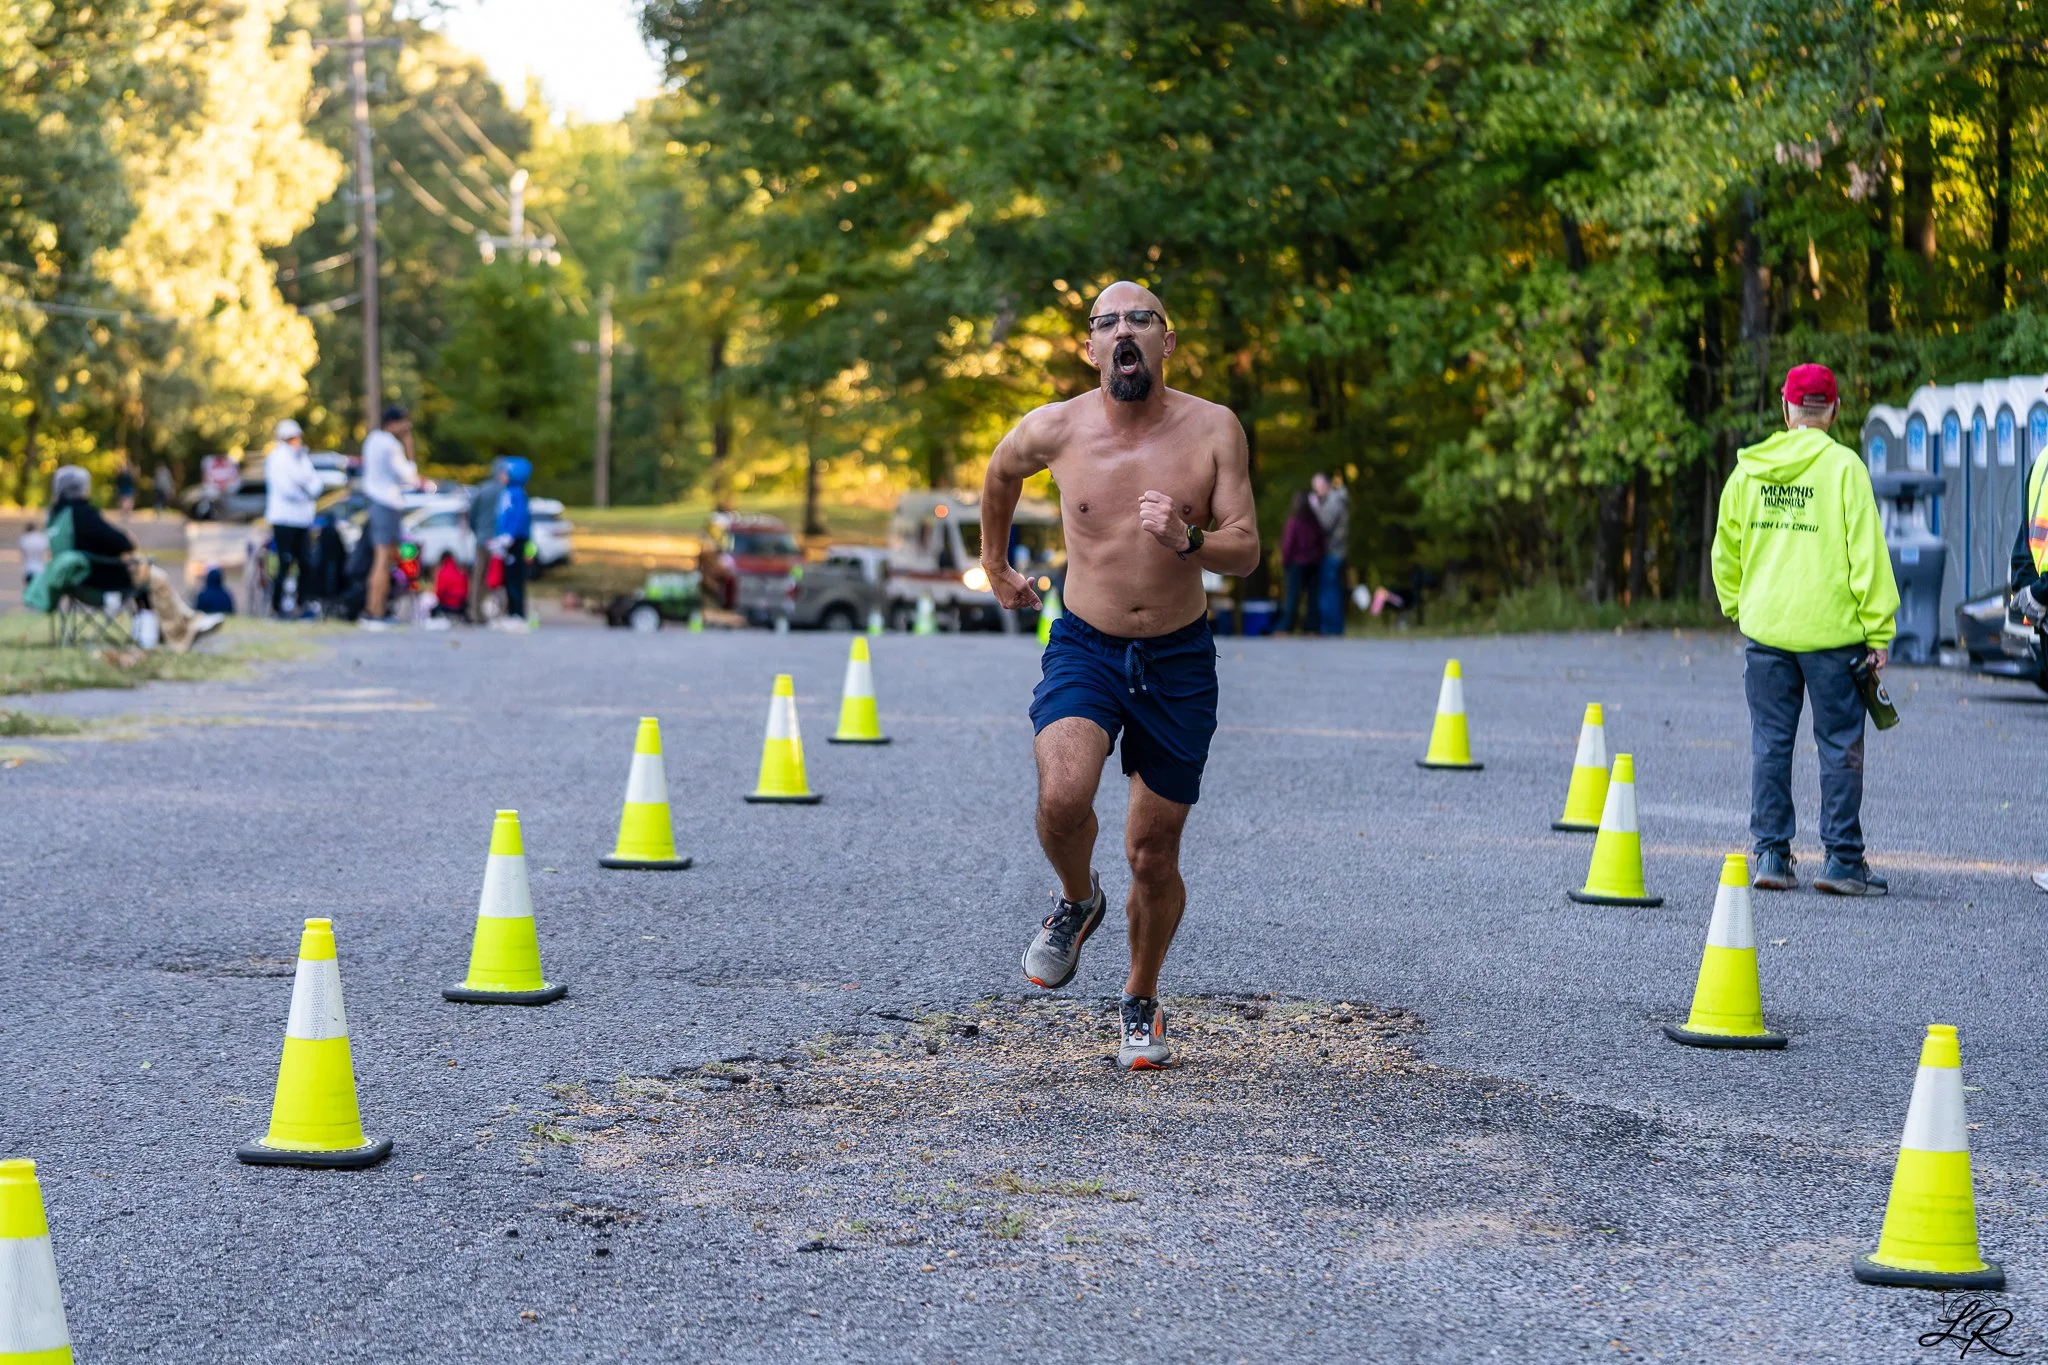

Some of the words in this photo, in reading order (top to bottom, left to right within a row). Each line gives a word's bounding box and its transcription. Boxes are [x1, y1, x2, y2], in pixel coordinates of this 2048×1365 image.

[1761, 484, 1814, 498] MEMPHIS
[1764, 497, 1805, 508] RUNNERS
[1751, 521, 1773, 530] FISH
[1792, 522, 1819, 532] CREW
